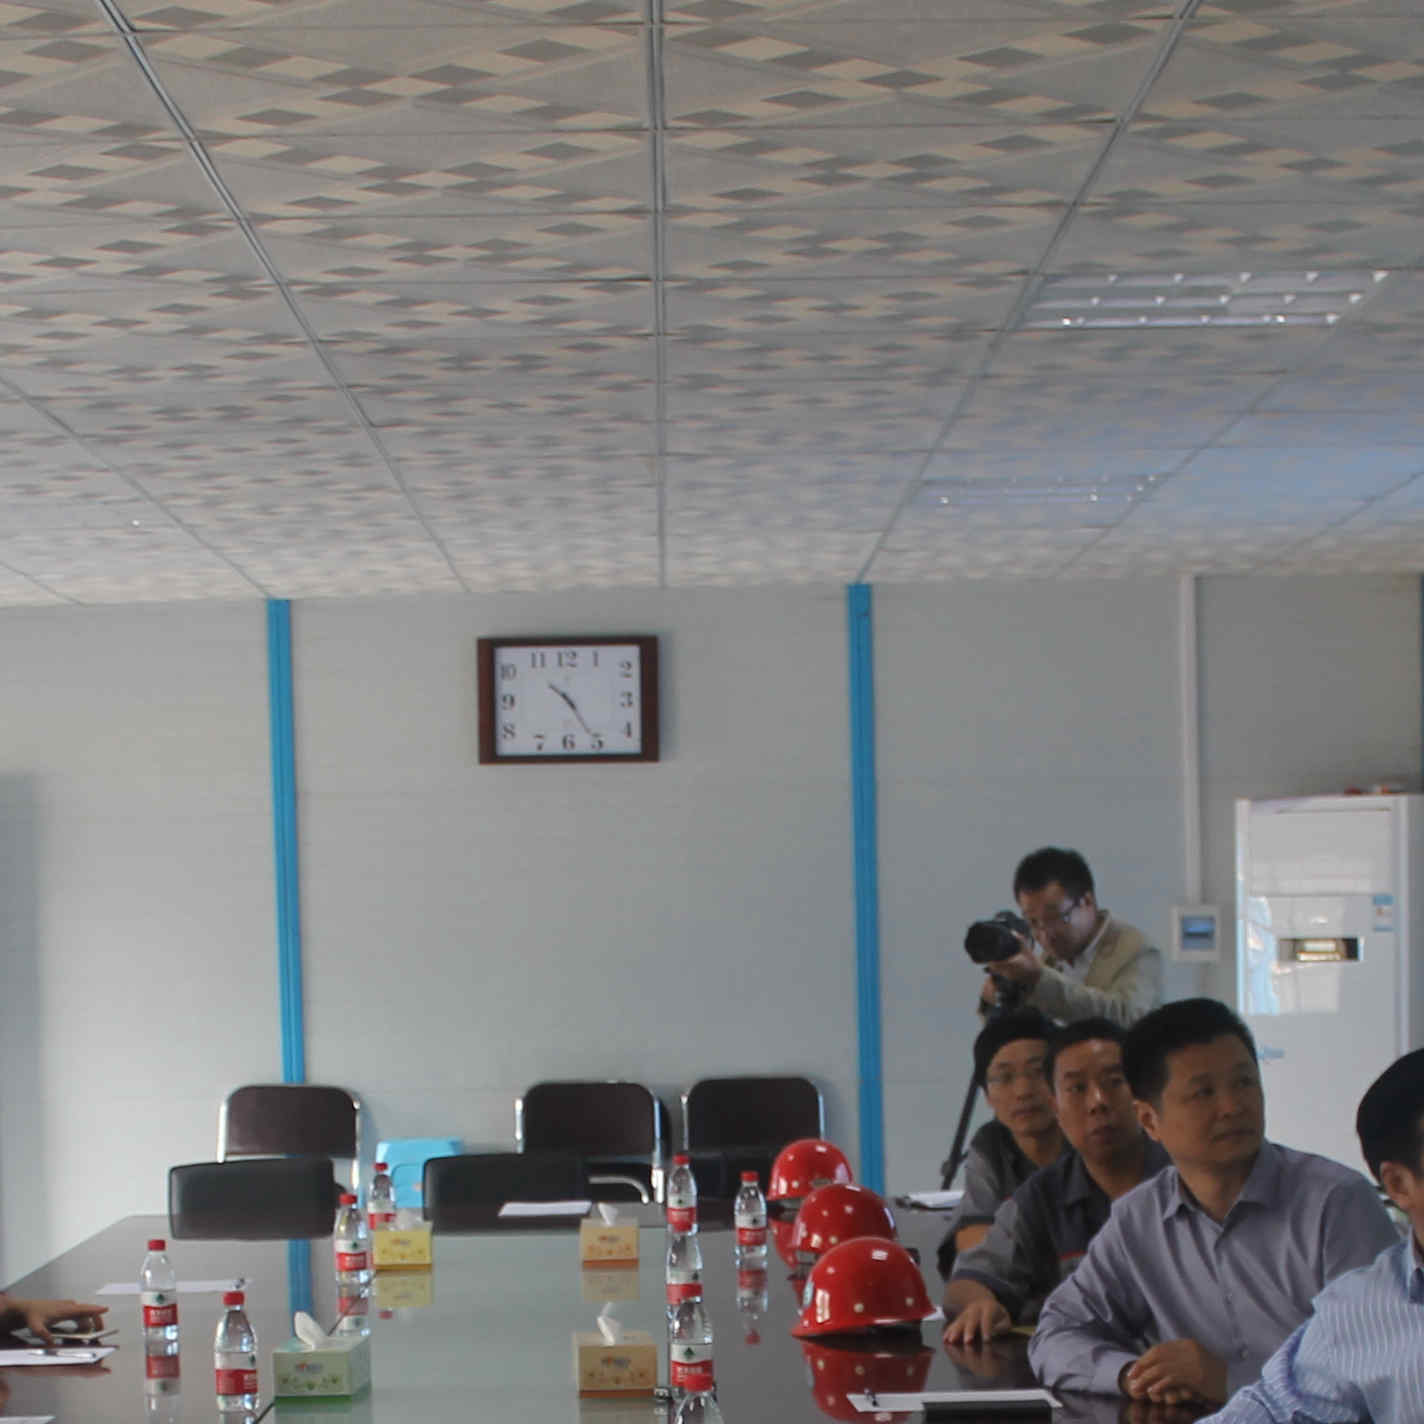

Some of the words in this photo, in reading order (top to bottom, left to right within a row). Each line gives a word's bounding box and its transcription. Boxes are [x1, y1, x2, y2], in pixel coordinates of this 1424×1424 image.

[530, 651, 546, 669] 11
[556, 650, 577, 669] 12
[591, 651, 600, 668] 1
[500, 663, 517, 681] 10
[619, 661, 632, 679] 2
[501, 694, 515, 711] 9
[619, 691, 633, 709] 3
[502, 723, 516, 740] 8
[621, 721, 633, 739] 4
[533, 734, 547, 752] 7
[562, 733, 576, 751] 6
[590, 731, 605, 751] 5
